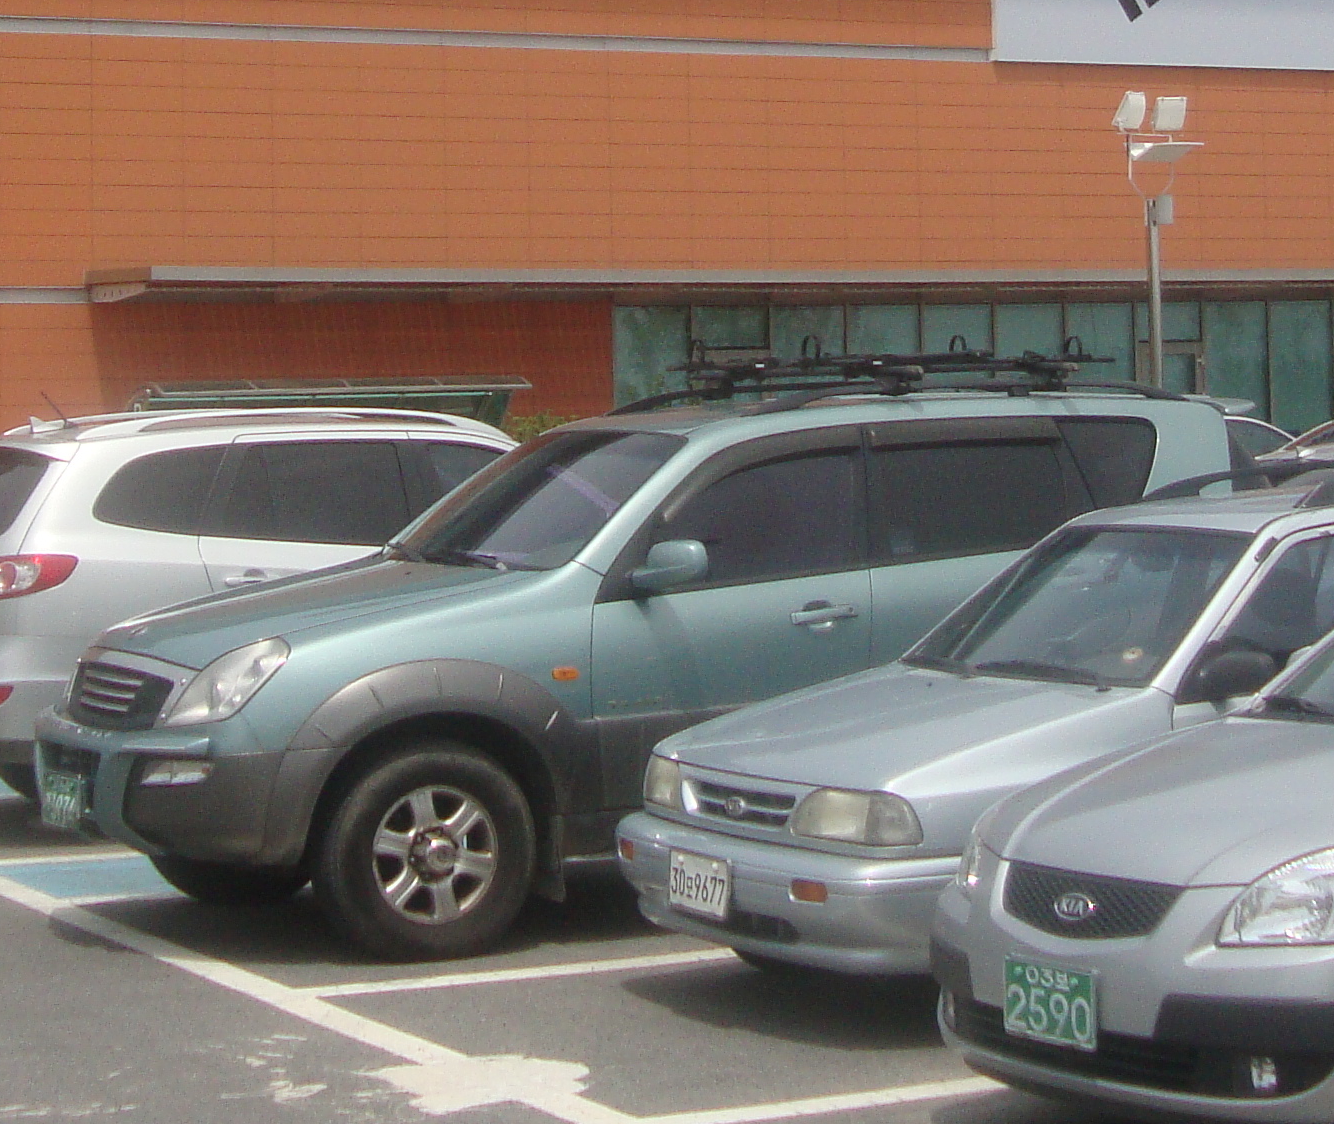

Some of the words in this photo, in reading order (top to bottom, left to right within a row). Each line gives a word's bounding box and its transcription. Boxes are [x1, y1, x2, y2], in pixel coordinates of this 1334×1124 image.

[670, 867, 725, 906] 30모9677
[1058, 896, 1086, 917] KIA
[1007, 983, 1091, 1042] 2590
